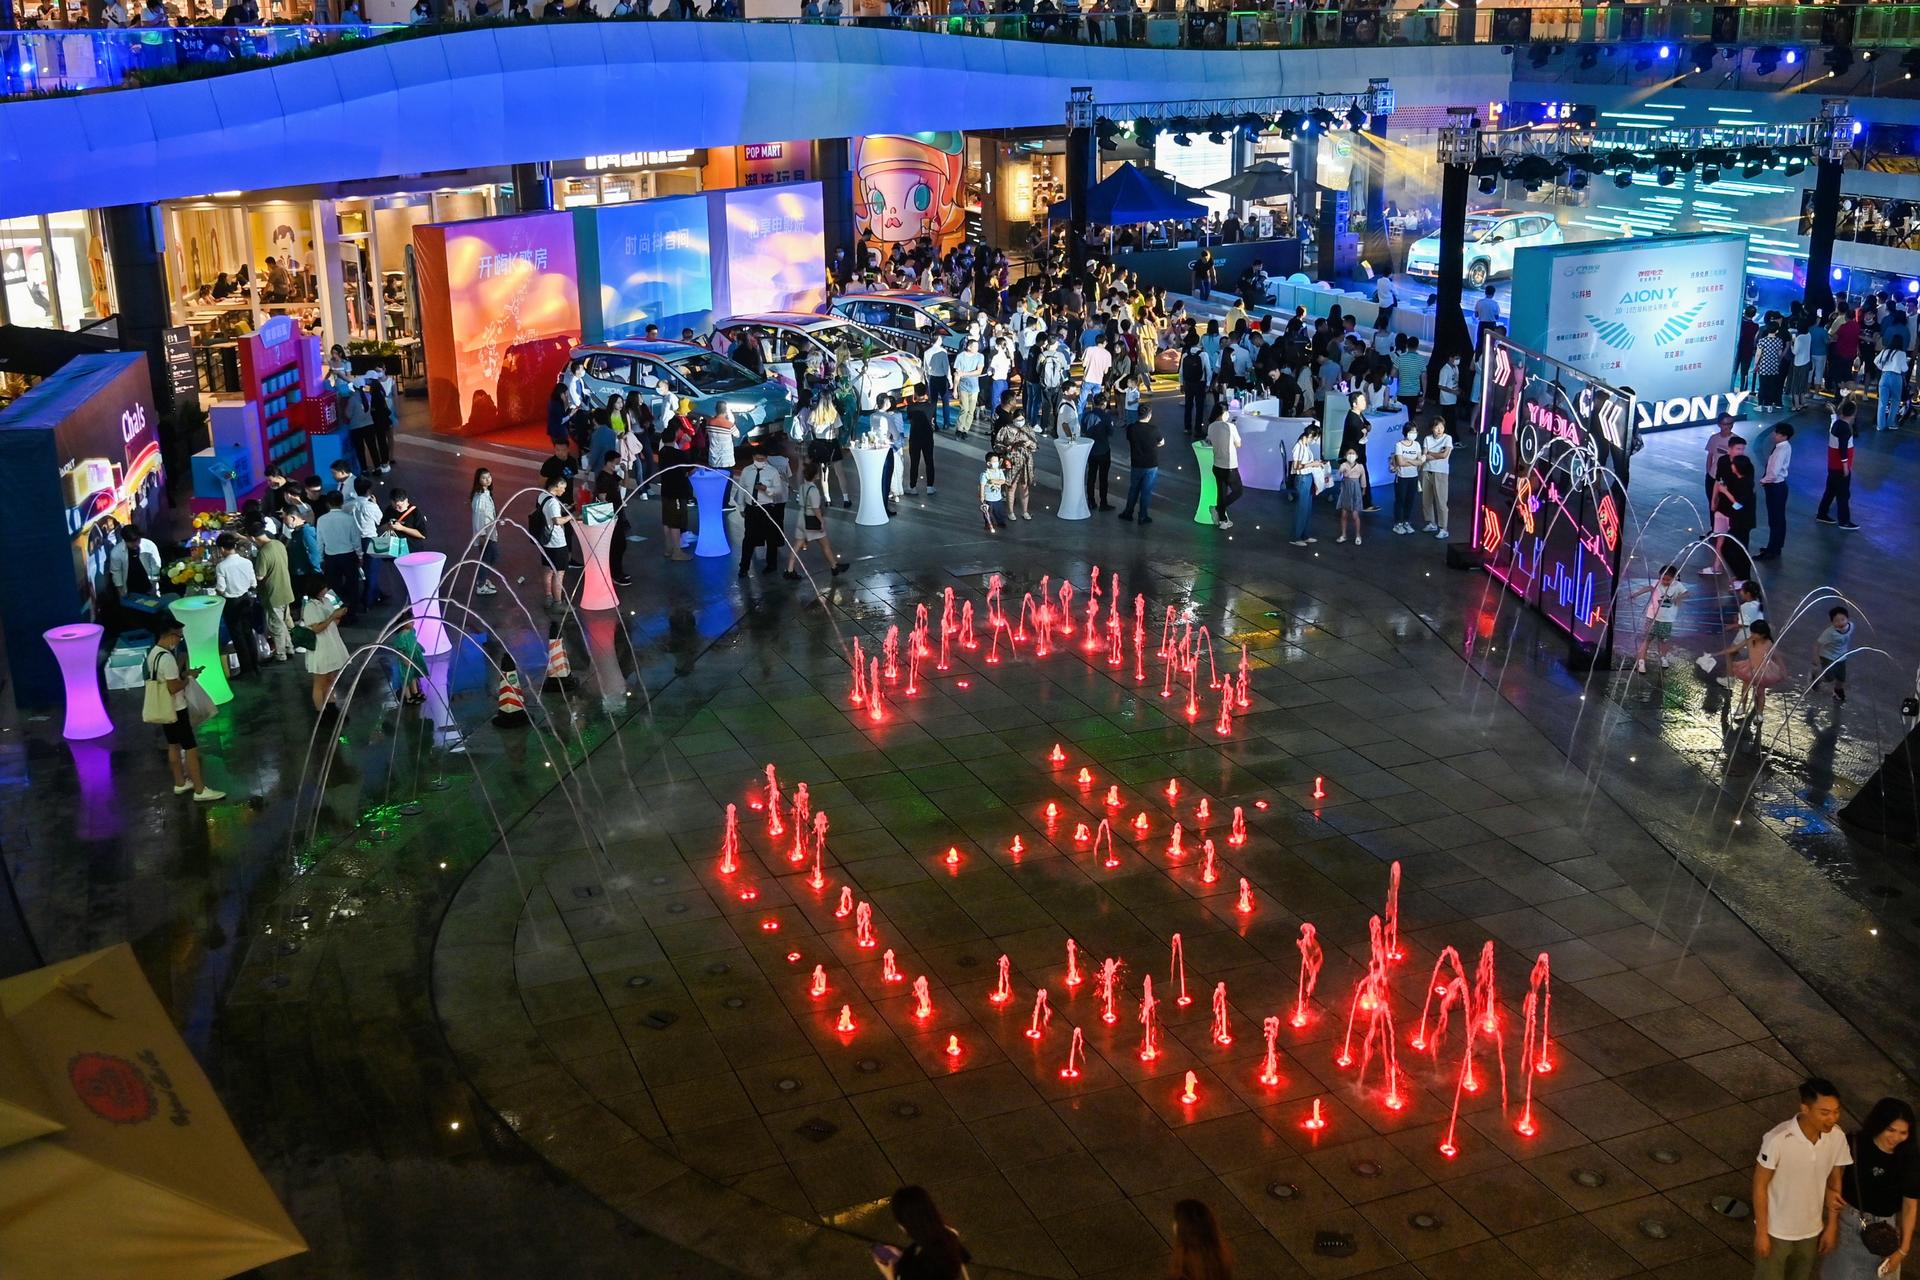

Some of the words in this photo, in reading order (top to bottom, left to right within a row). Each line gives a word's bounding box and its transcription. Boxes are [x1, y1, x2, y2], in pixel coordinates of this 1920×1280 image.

[745, 146, 760, 159] POP
[761, 144, 781, 157] MART
[479, 248, 547, 278] 开嗨K歌房
[1619, 289, 1663, 304] AION
[1668, 287, 1678, 299] Y
[167, 334, 178, 343] B1
[1637, 395, 1718, 429] AION
[1719, 391, 1750, 416] Y
